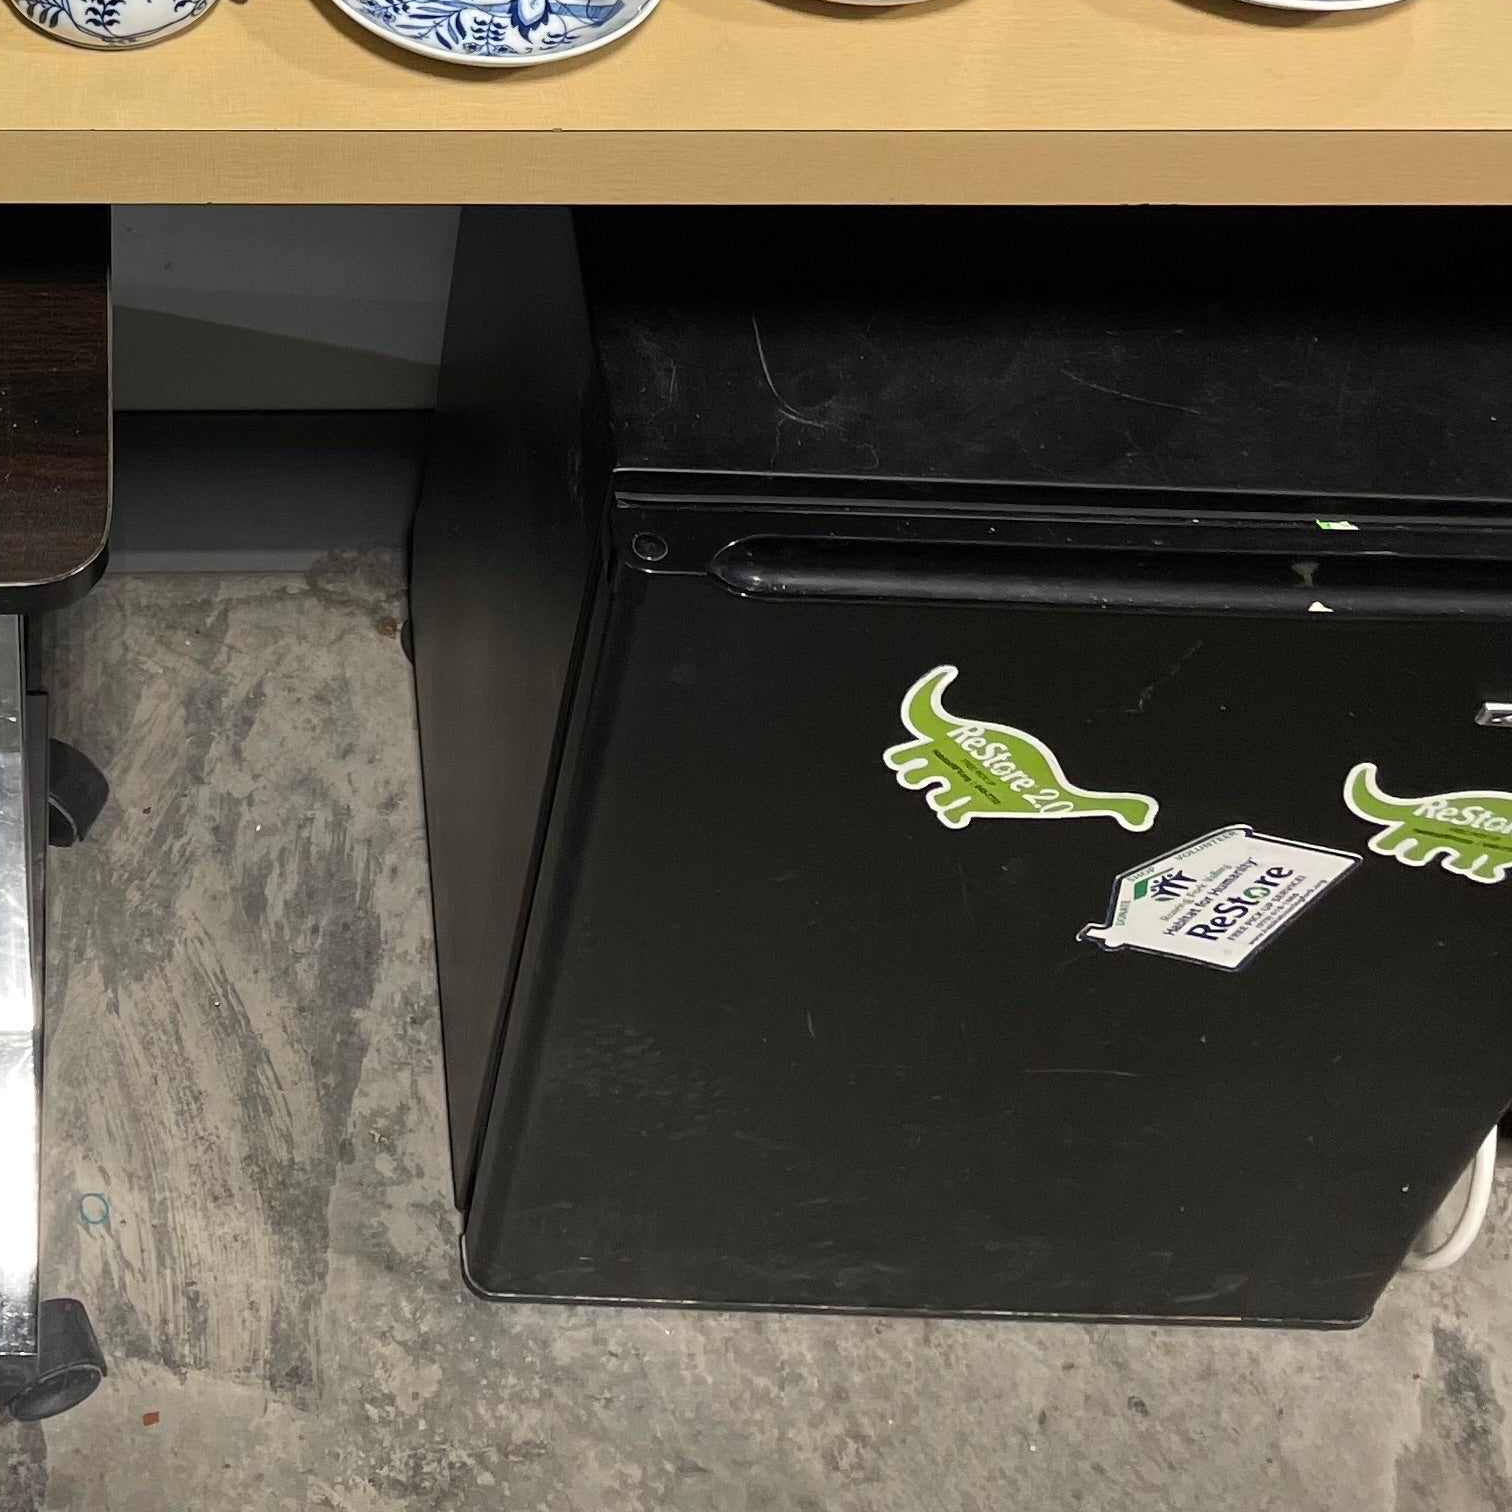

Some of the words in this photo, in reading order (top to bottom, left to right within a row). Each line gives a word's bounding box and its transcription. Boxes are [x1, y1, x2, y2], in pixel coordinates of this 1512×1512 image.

[946, 725, 1036, 792] ReStore
[1021, 789, 1075, 814] 2.0
[1174, 830, 1238, 861] VOLUNTEER
[1163, 908, 1201, 936] Habitat
[1194, 896, 1213, 907] for
[1208, 857, 1258, 896] Humanity
[1184, 866, 1293, 941] ReStore
